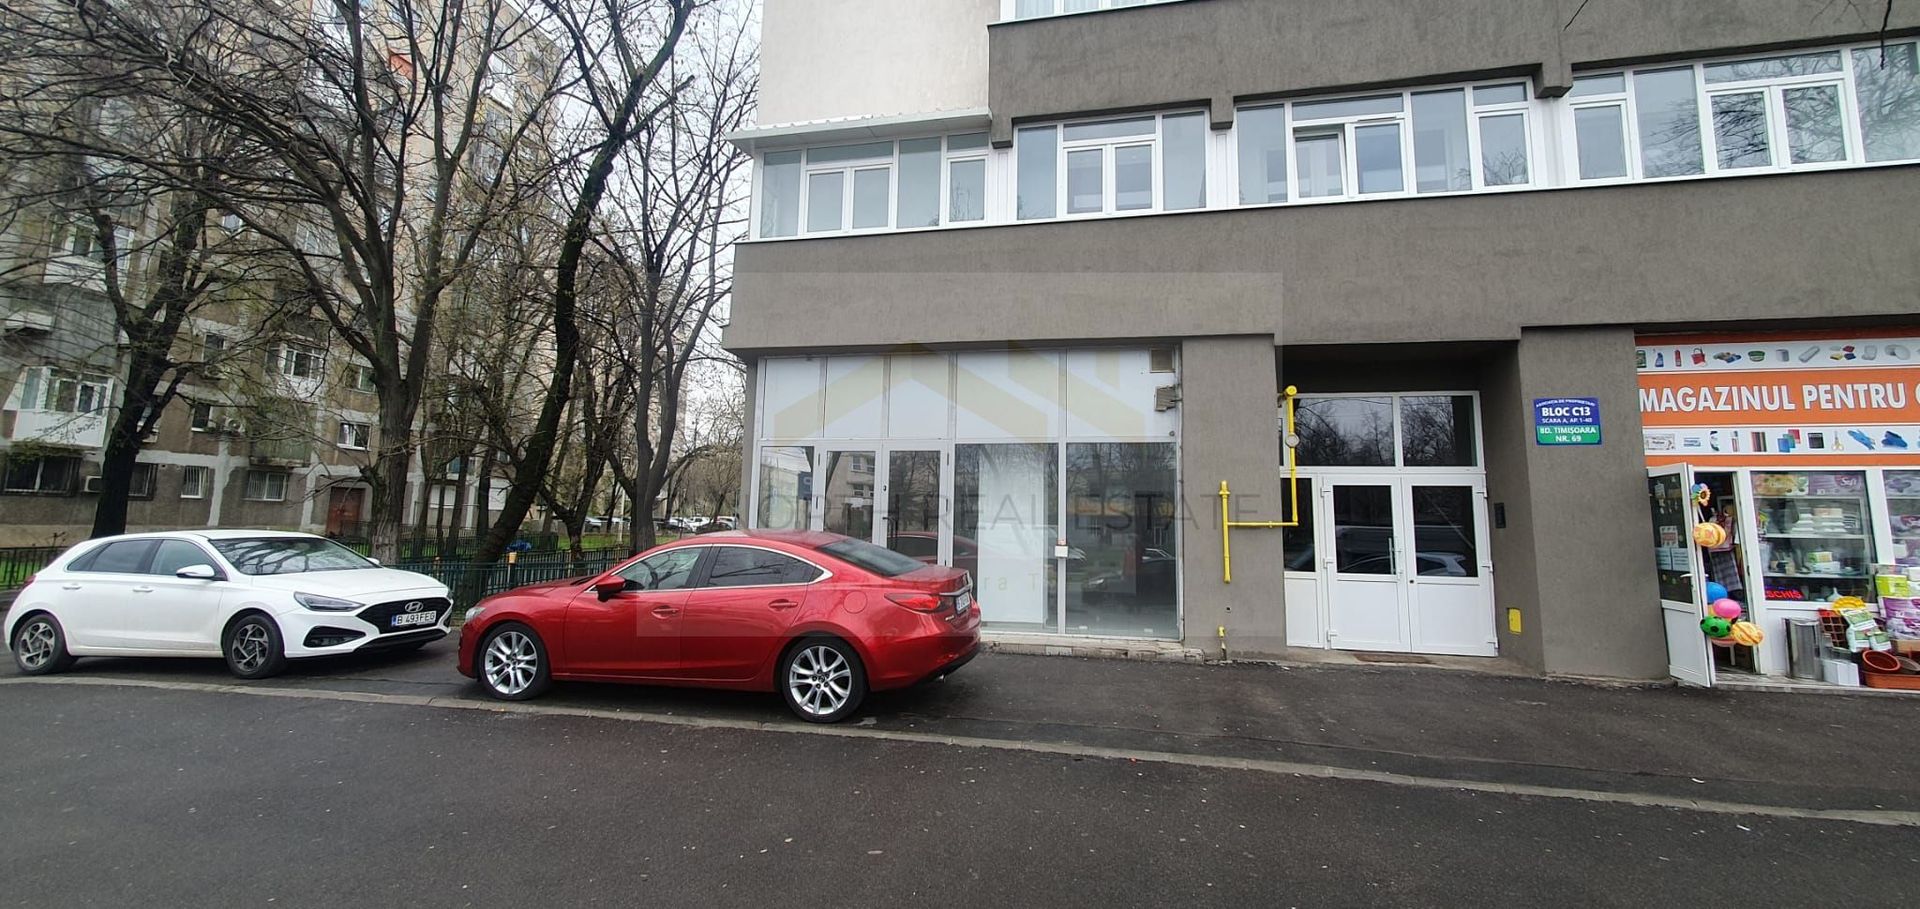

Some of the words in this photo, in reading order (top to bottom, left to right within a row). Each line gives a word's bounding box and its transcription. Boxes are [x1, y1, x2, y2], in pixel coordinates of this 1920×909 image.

[1639, 385, 1796, 412] MAGAZINUL
[1802, 382, 1906, 410] PENTRU
[1541, 407, 1570, 416] BLOC
[1571, 407, 1591, 416] C13
